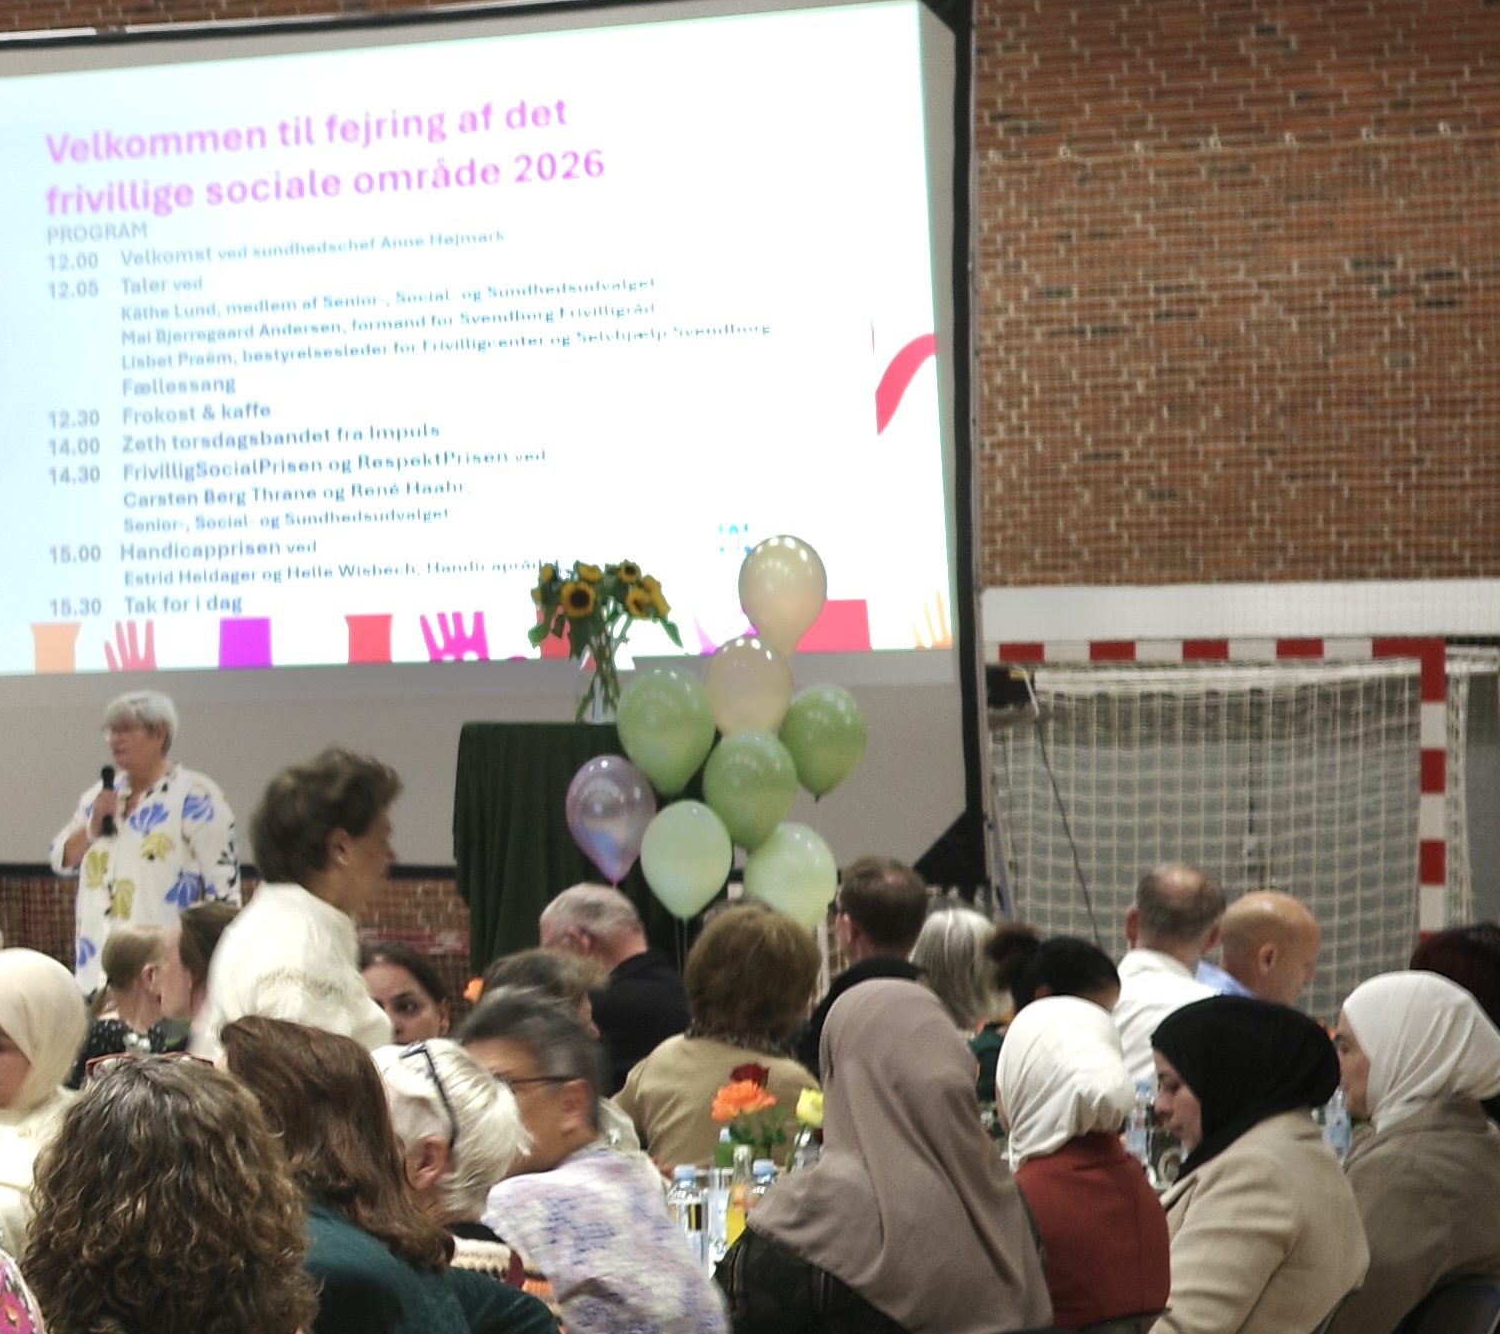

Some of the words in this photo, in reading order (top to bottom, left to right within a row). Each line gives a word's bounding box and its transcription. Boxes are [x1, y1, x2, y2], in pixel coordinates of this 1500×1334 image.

[46, 124, 266, 165] Velkommen
[277, 116, 315, 147] til
[325, 107, 448, 148] fejring
[458, 102, 493, 133] af
[504, 98, 567, 129] det
[46, 178, 194, 218] frivillige
[206, 168, 341, 208] sociale
[353, 156, 501, 195] område
[514, 148, 605, 184] 2026
[47, 220, 148, 244] PROGRAM
[47, 251, 99, 272] 12.00
[120, 246, 212, 267] Velkomst
[218, 244, 247, 261] ved
[252, 236, 376, 259] sundhedschef
[380, 235, 424, 251] Anne
[429, 229, 505, 249] Højmark
[47, 279, 99, 300] 12.05
[121, 275, 167, 295] Taler
[173, 274, 203, 292] ved
[121, 305, 169, 322] Käthe
[174, 301, 221, 319] Lund,
[226, 299, 296, 316] medlem
[302, 295, 318, 311] af
[461, 288, 481, 304] og
[121, 329, 151, 347] Mai
[156, 324, 254, 347] Bjerregaard
[259, 322, 346, 338] Andersen,
[351, 314, 426, 333] formand
[431, 313, 453, 328] for
[122, 353, 174, 371] Lisbet
[242, 342, 387, 367] bestyrelsesleder
[394, 340, 415, 355] for
[122, 376, 236, 398] Fællessang
[48, 408, 100, 430] 12.30
[123, 404, 197, 426] Frokost
[202, 403, 215, 421] &
[222, 401, 271, 421] kaffe
[48, 435, 100, 457] 14.00
[172, 426, 330, 452] torsdagsbandet
[337, 425, 363, 443] fra
[370, 422, 440, 443] Impuls
[48, 464, 100, 486] 14.30
[124, 457, 322, 483] FrivilligSocialPrisen
[328, 458, 351, 475] og
[358, 449, 508, 473] RespektPrisen
[515, 448, 546, 463] ved
[123, 490, 198, 509] Carsten
[204, 487, 246, 507] Berg
[251, 485, 316, 504] Thrane
[323, 487, 344, 503] og
[351, 480, 400, 498] René
[260, 515, 280, 530] og
[285, 507, 449, 527] Sundhedsudvalget
[49, 543, 102, 564] 15.00
[120, 539, 280, 562] Handicapprisen
[286, 539, 317, 554] ved
[124, 568, 174, 587] Estrid
[178, 567, 257, 586] Heldager
[262, 569, 282, 584] og
[287, 564, 332, 580] Helle
[50, 595, 102, 618] 15.30
[124, 594, 157, 615] Tak
[163, 593, 190, 615] for
[195, 593, 200, 612] i
[206, 593, 243, 615] dag
